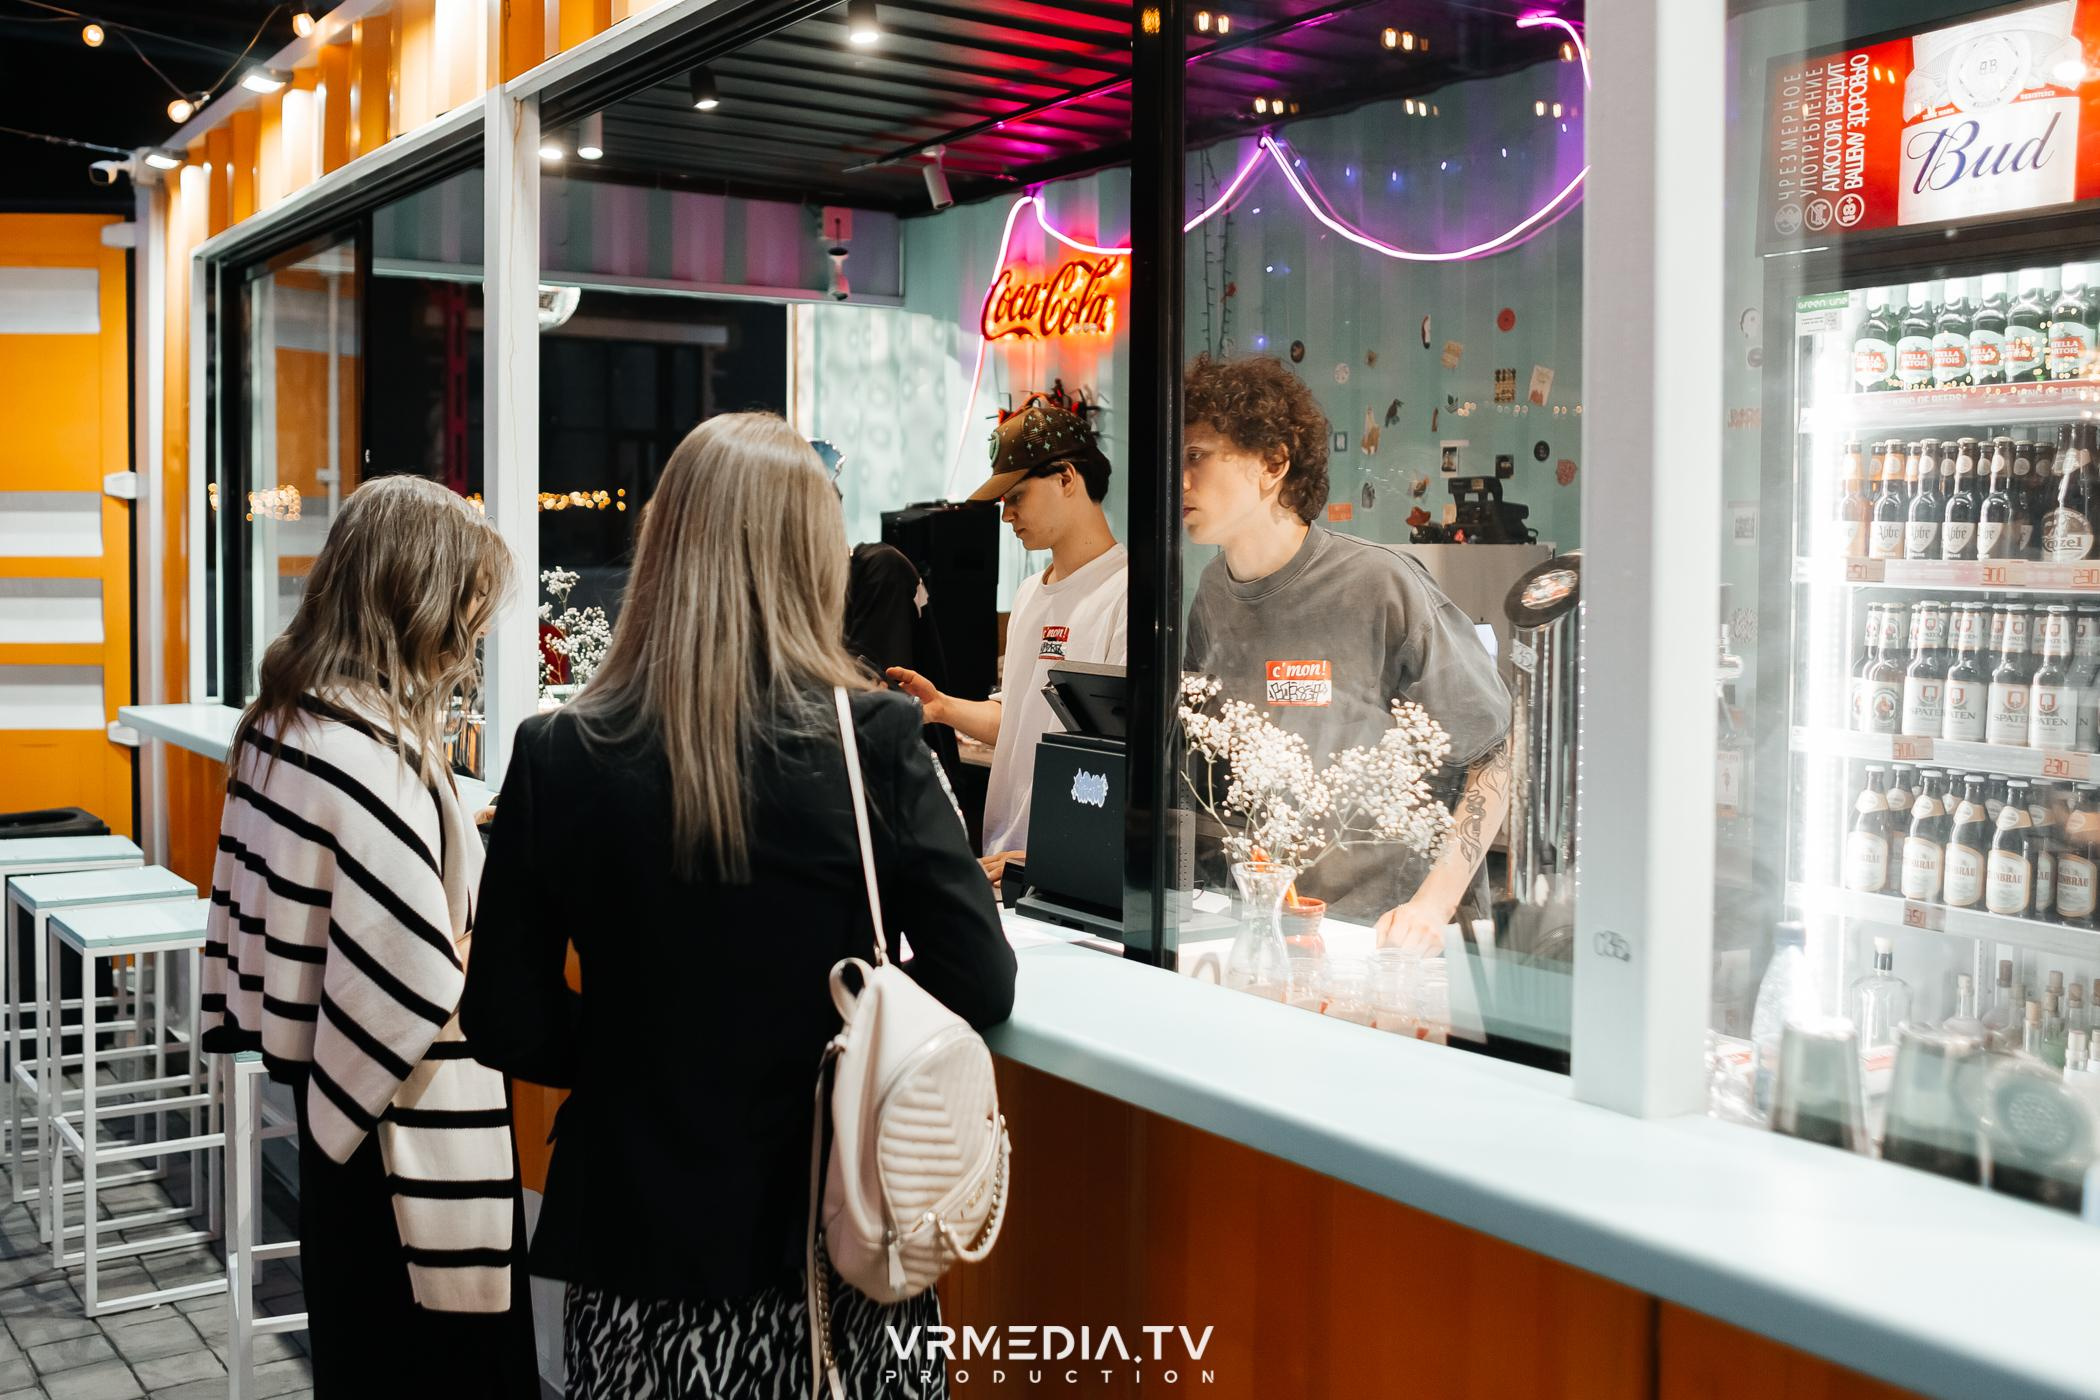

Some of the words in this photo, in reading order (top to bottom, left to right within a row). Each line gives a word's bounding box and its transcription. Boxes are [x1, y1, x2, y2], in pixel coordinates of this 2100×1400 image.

[1825, 62, 1846, 116] ВРЕДИТ
[1847, 54, 1869, 128] ЗДОРОВЬЮ
[1778, 73, 1801, 201] ЧРЕЗМЕРНОЕ
[1800, 67, 1824, 198] УПОТРЕБЛЕНИЕ
[1822, 118, 1842, 192] АЛКОГОЛЯ
[1844, 133, 1865, 190] ВАШЕМУ
[1906, 112, 2062, 195] Bud
[1842, 196, 1856, 222] 18+
[981, 254, 1120, 341] Coca-Cola
[1272, 660, 1327, 678] c'mon!
[1993, 713, 2028, 724] SPATE
[2038, 717, 2069, 727] ATEN
